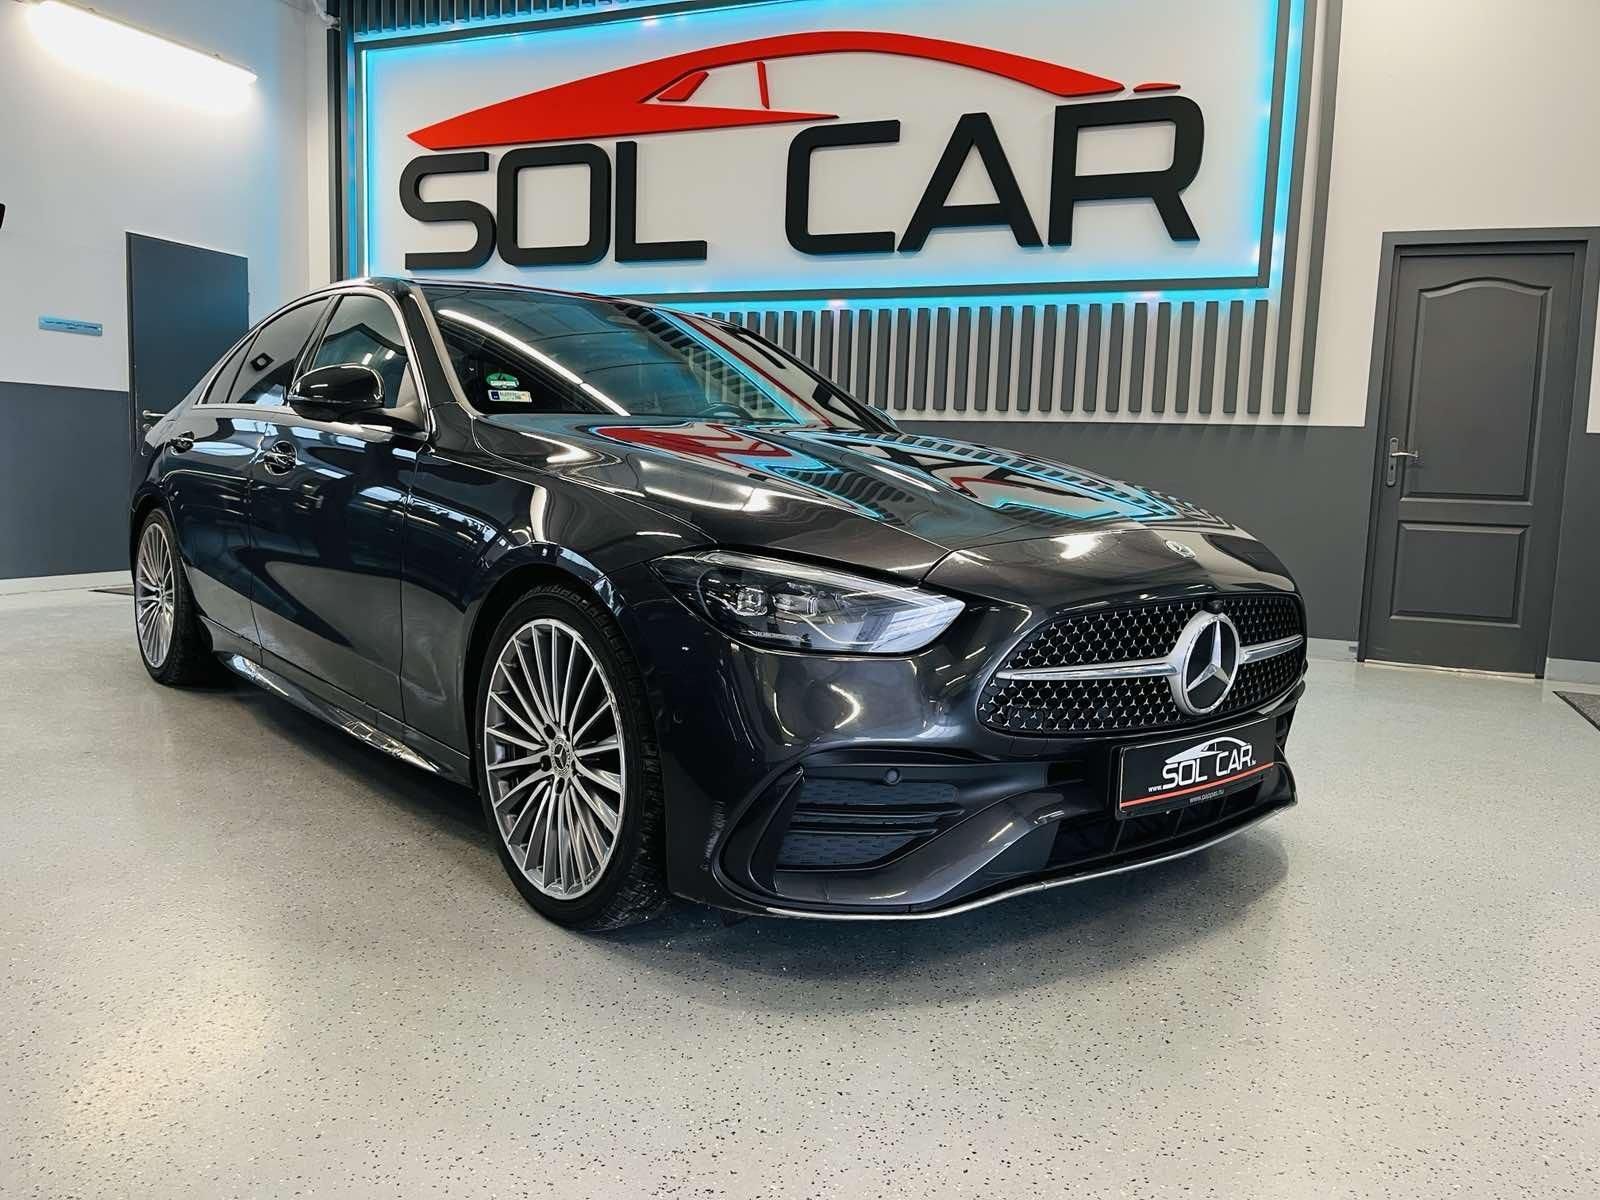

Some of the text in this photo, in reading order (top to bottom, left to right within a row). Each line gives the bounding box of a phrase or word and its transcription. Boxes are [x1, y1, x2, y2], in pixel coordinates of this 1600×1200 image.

[399, 95, 1205, 270] SOL CAR
[1162, 757, 1208, 790] SOL
